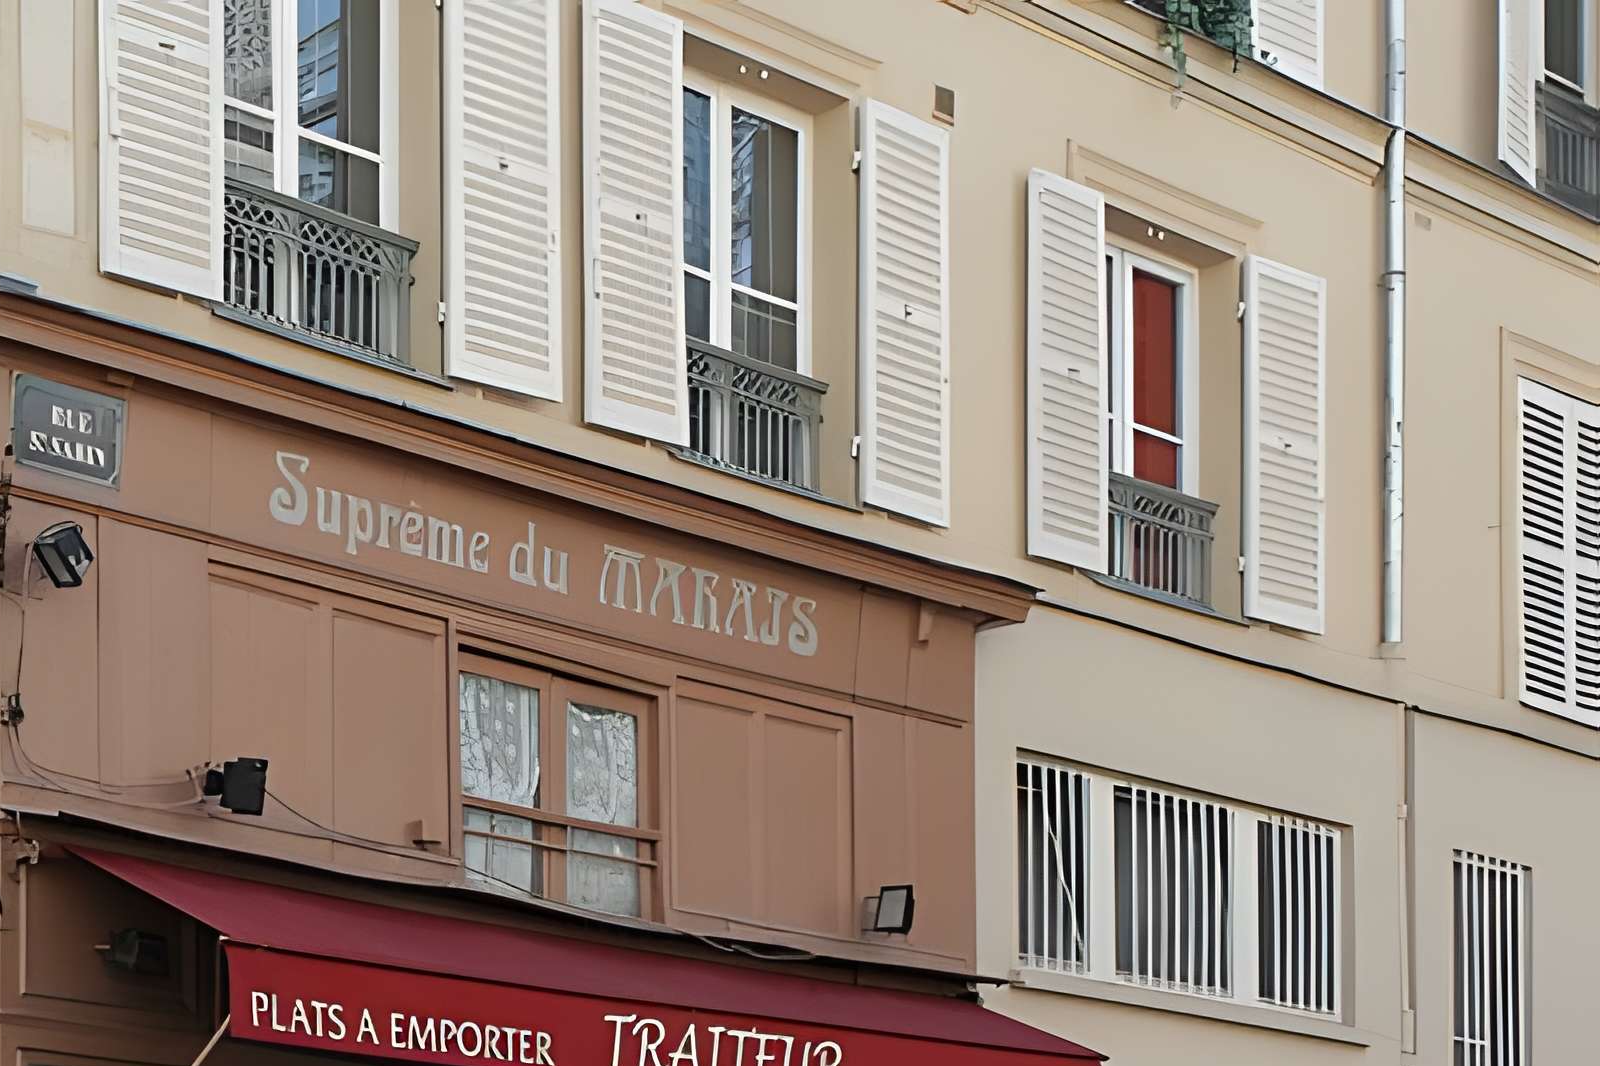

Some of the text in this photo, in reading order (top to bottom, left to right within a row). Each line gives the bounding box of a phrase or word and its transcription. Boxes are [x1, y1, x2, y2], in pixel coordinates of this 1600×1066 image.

[509, 521, 569, 594] du
[600, 544, 818, 656] MARAIS
[250, 991, 346, 1041] PLATS
[390, 1012, 555, 1066] EMPORTER
